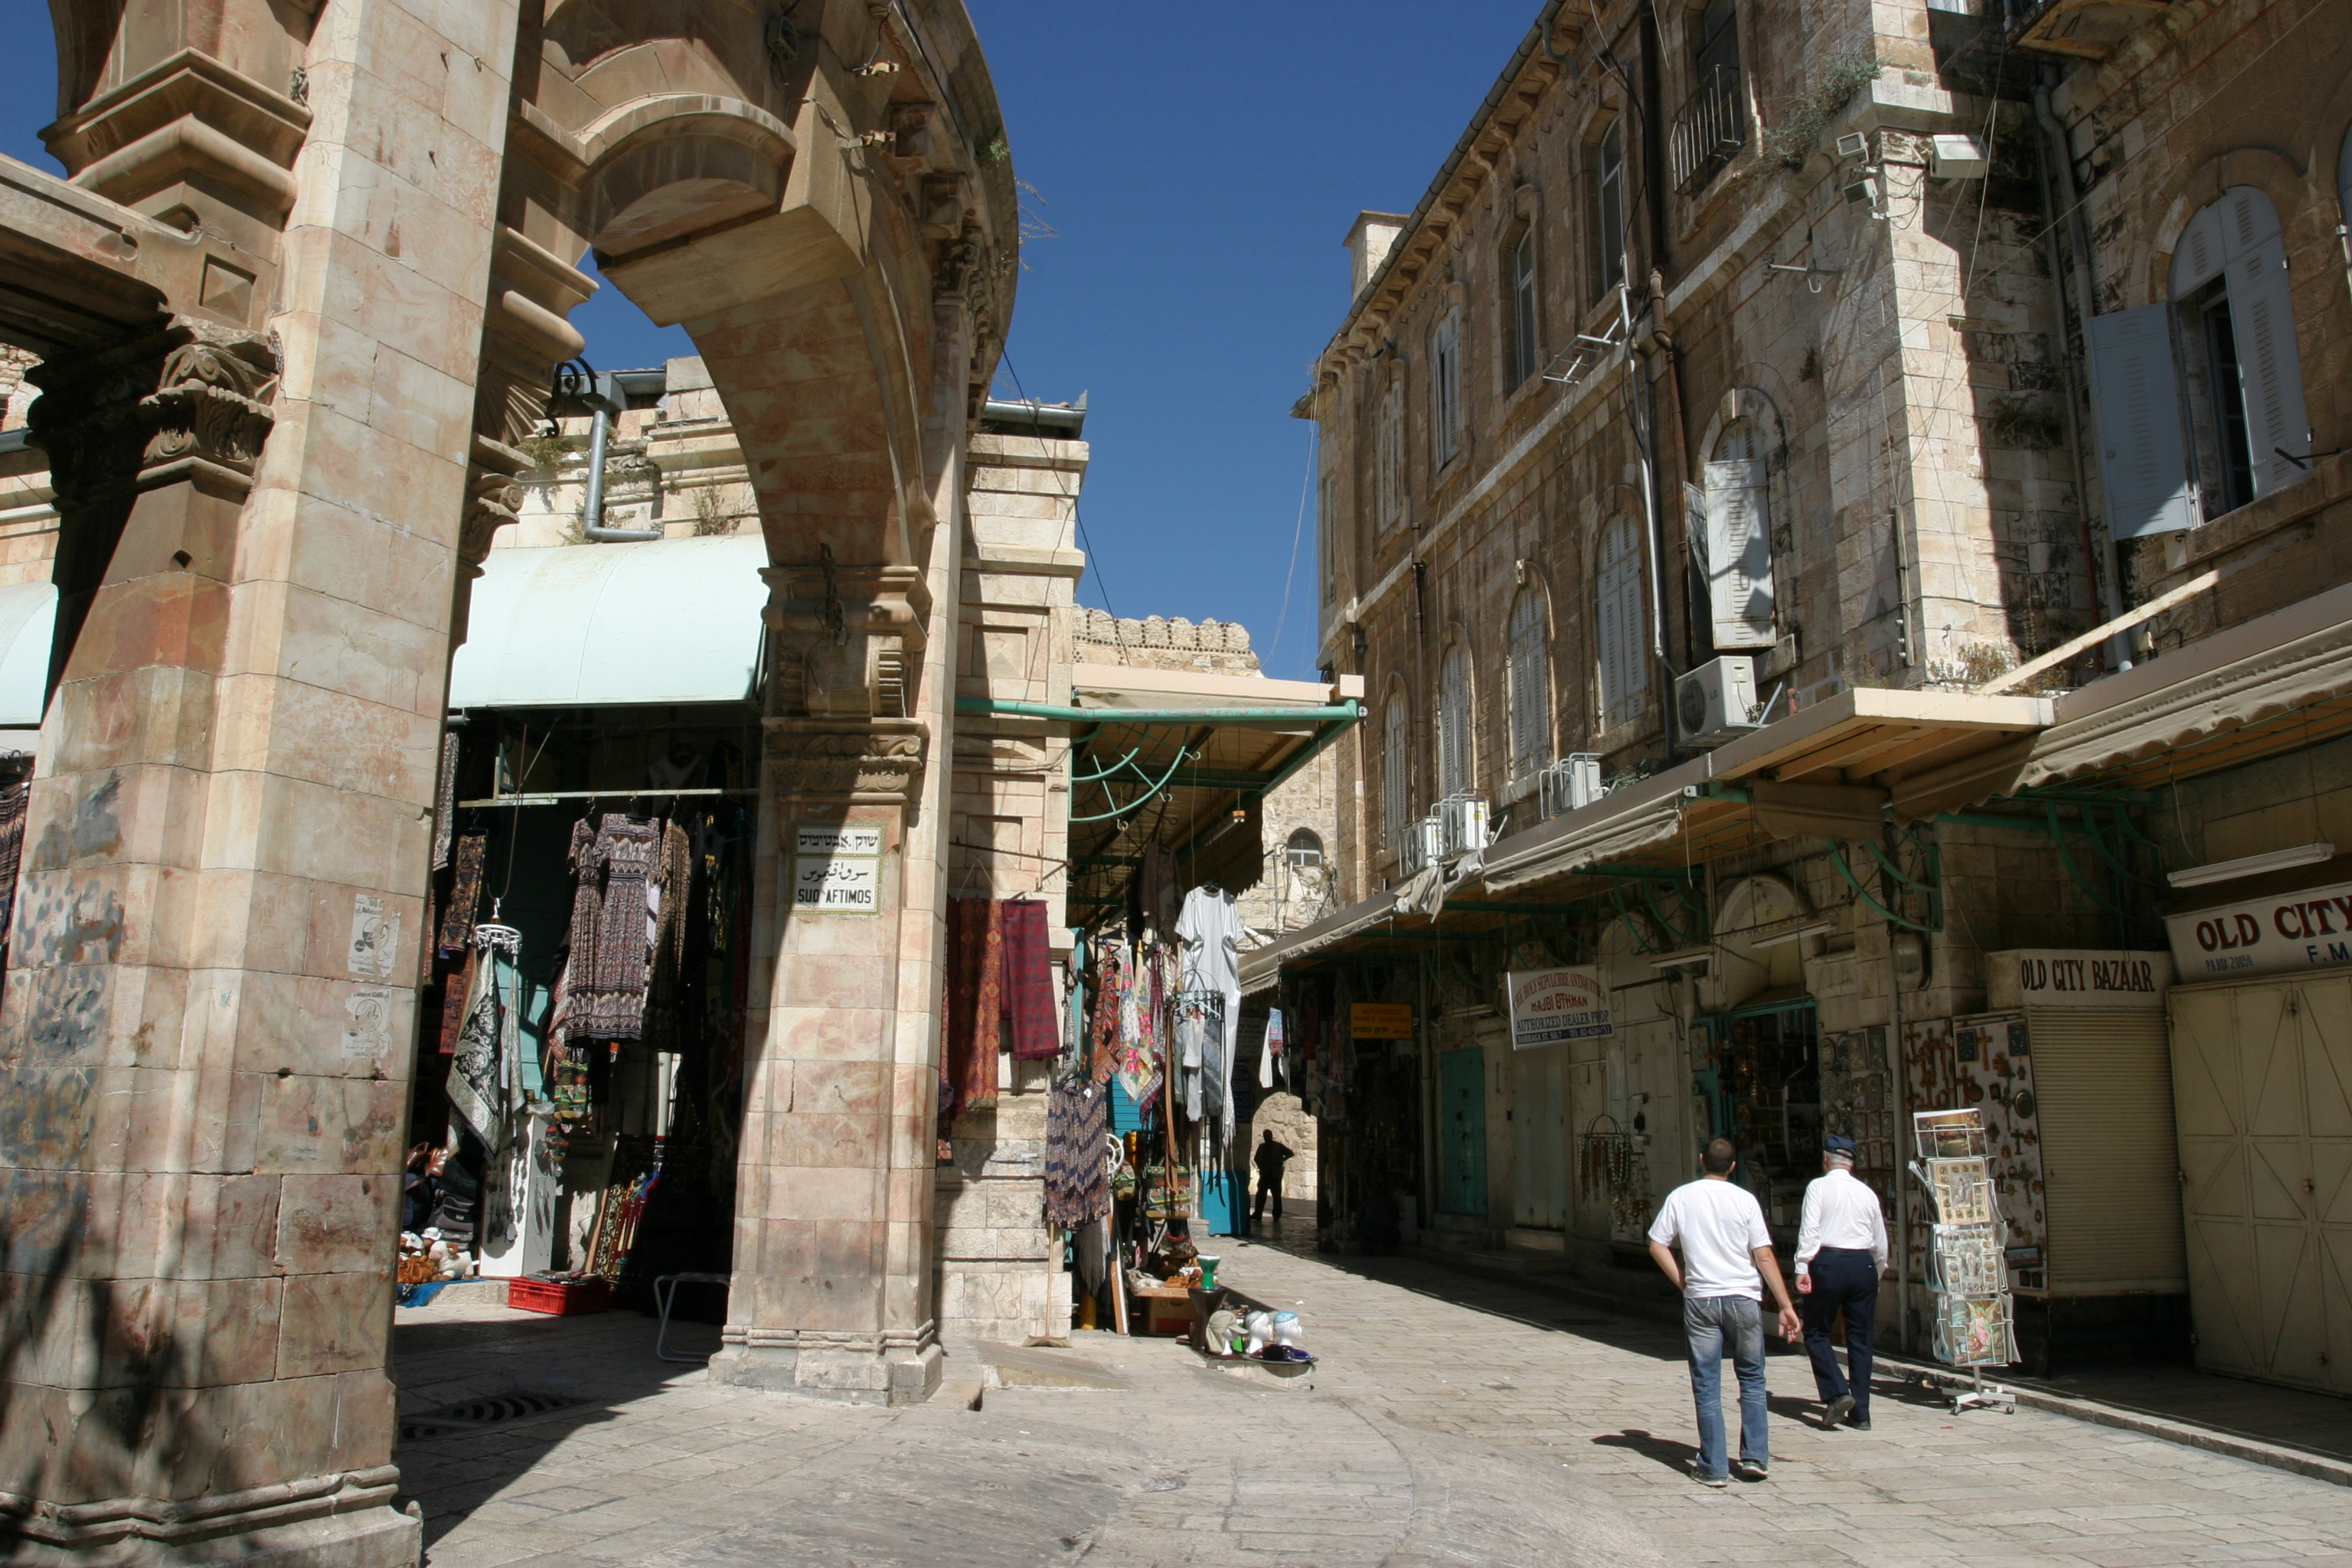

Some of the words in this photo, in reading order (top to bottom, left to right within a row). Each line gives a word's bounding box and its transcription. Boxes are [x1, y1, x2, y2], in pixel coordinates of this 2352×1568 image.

[825, 889, 872, 903] AFTIMOS
[2196, 913, 2261, 952] OLD
[2020, 959, 2047, 991] OLD
[2052, 959, 2086, 991] CITY
[2092, 959, 2156, 993] BAZAAR
[1513, 988, 1524, 1014] THE
[1523, 978, 1537, 999] HOLY
[1537, 972, 1570, 991] SEPULCHRE
[1555, 993, 1588, 1009] OTHMAN
[1517, 1015, 1560, 1032] AUTHORIZED
[1563, 1013, 1590, 1027] DEALER
[1592, 1010, 1609, 1024] PROP
